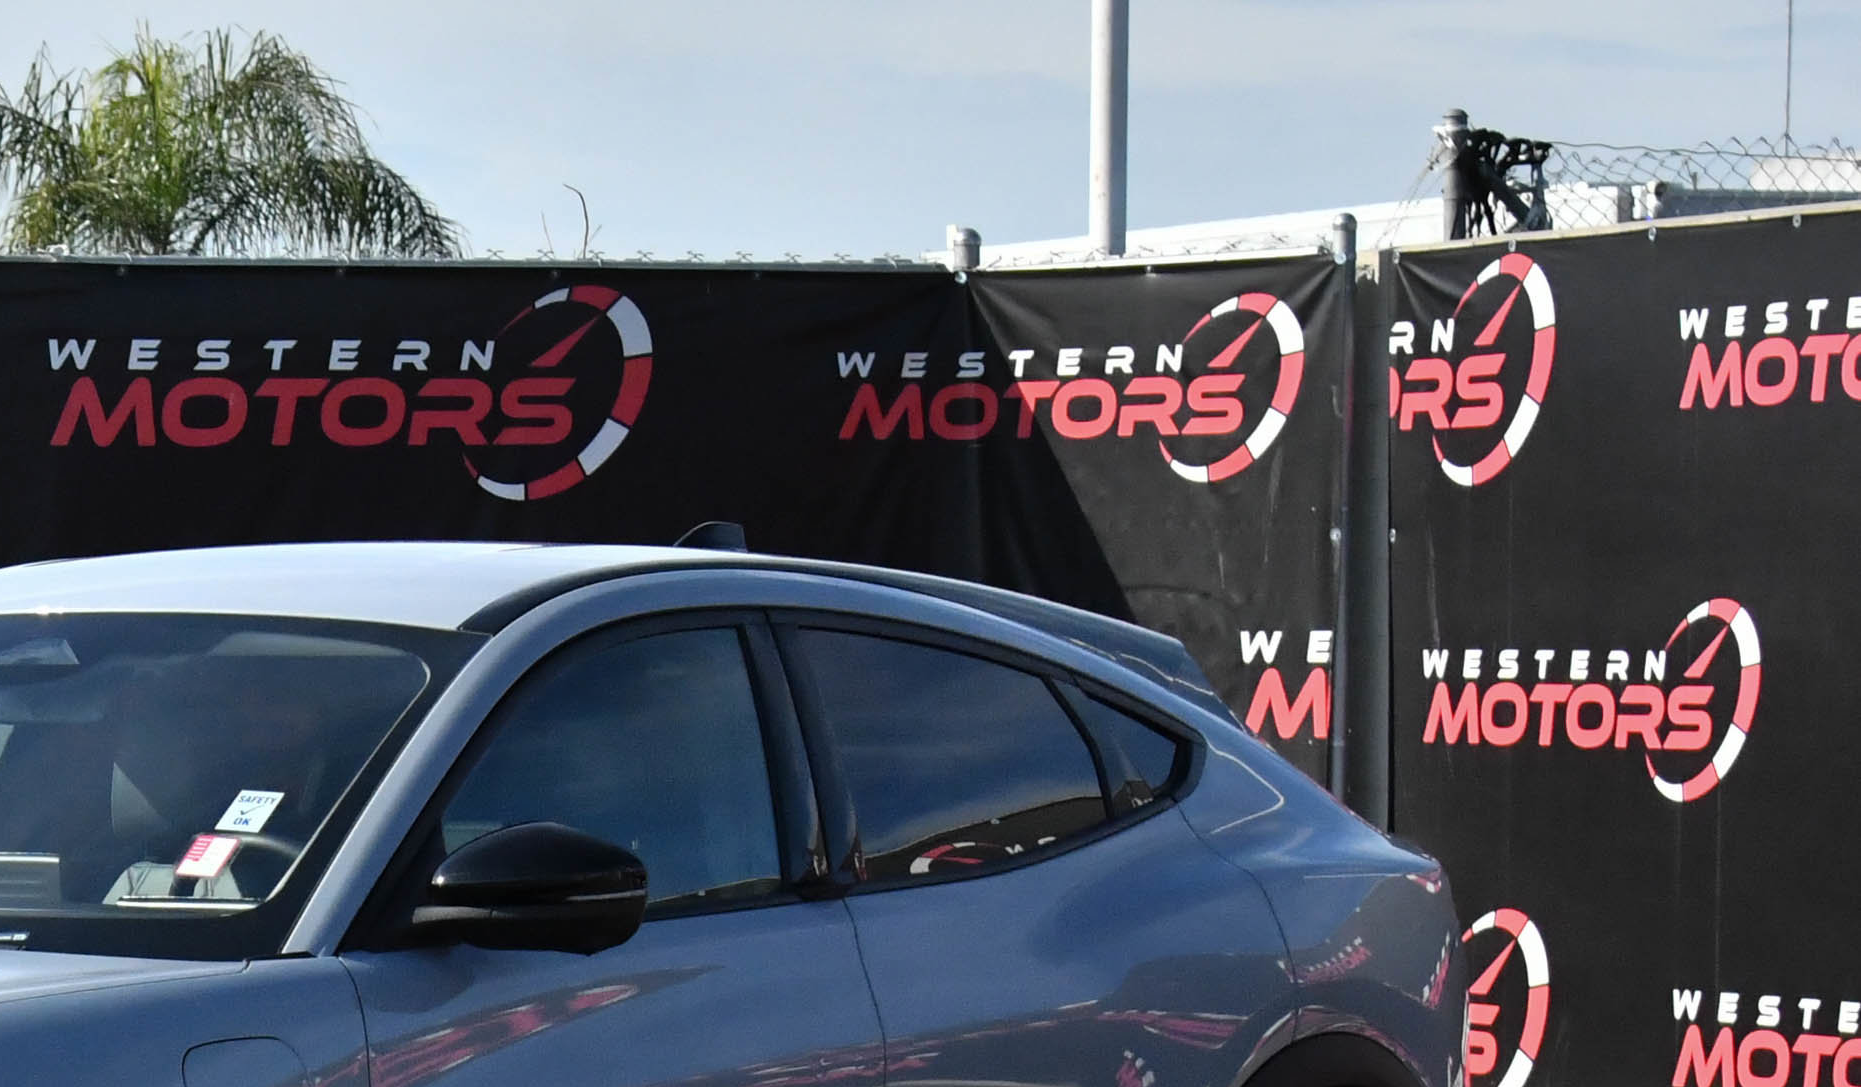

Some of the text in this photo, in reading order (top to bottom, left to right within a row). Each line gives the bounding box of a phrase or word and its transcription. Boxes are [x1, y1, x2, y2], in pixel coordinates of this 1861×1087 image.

[49, 340, 494, 371] WESTERN
[838, 344, 1183, 379] WESTERN
[50, 377, 576, 447] MOTORS
[840, 373, 1246, 440] MOTORS
[1389, 353, 1506, 431] RS
[1423, 649, 1666, 682] WESTERN
[1422, 683, 1714, 750] MOTORS
[238, 795, 278, 805] SAFETY
[233, 817, 253, 826] OK
[1673, 989, 1861, 1034] WESTE
